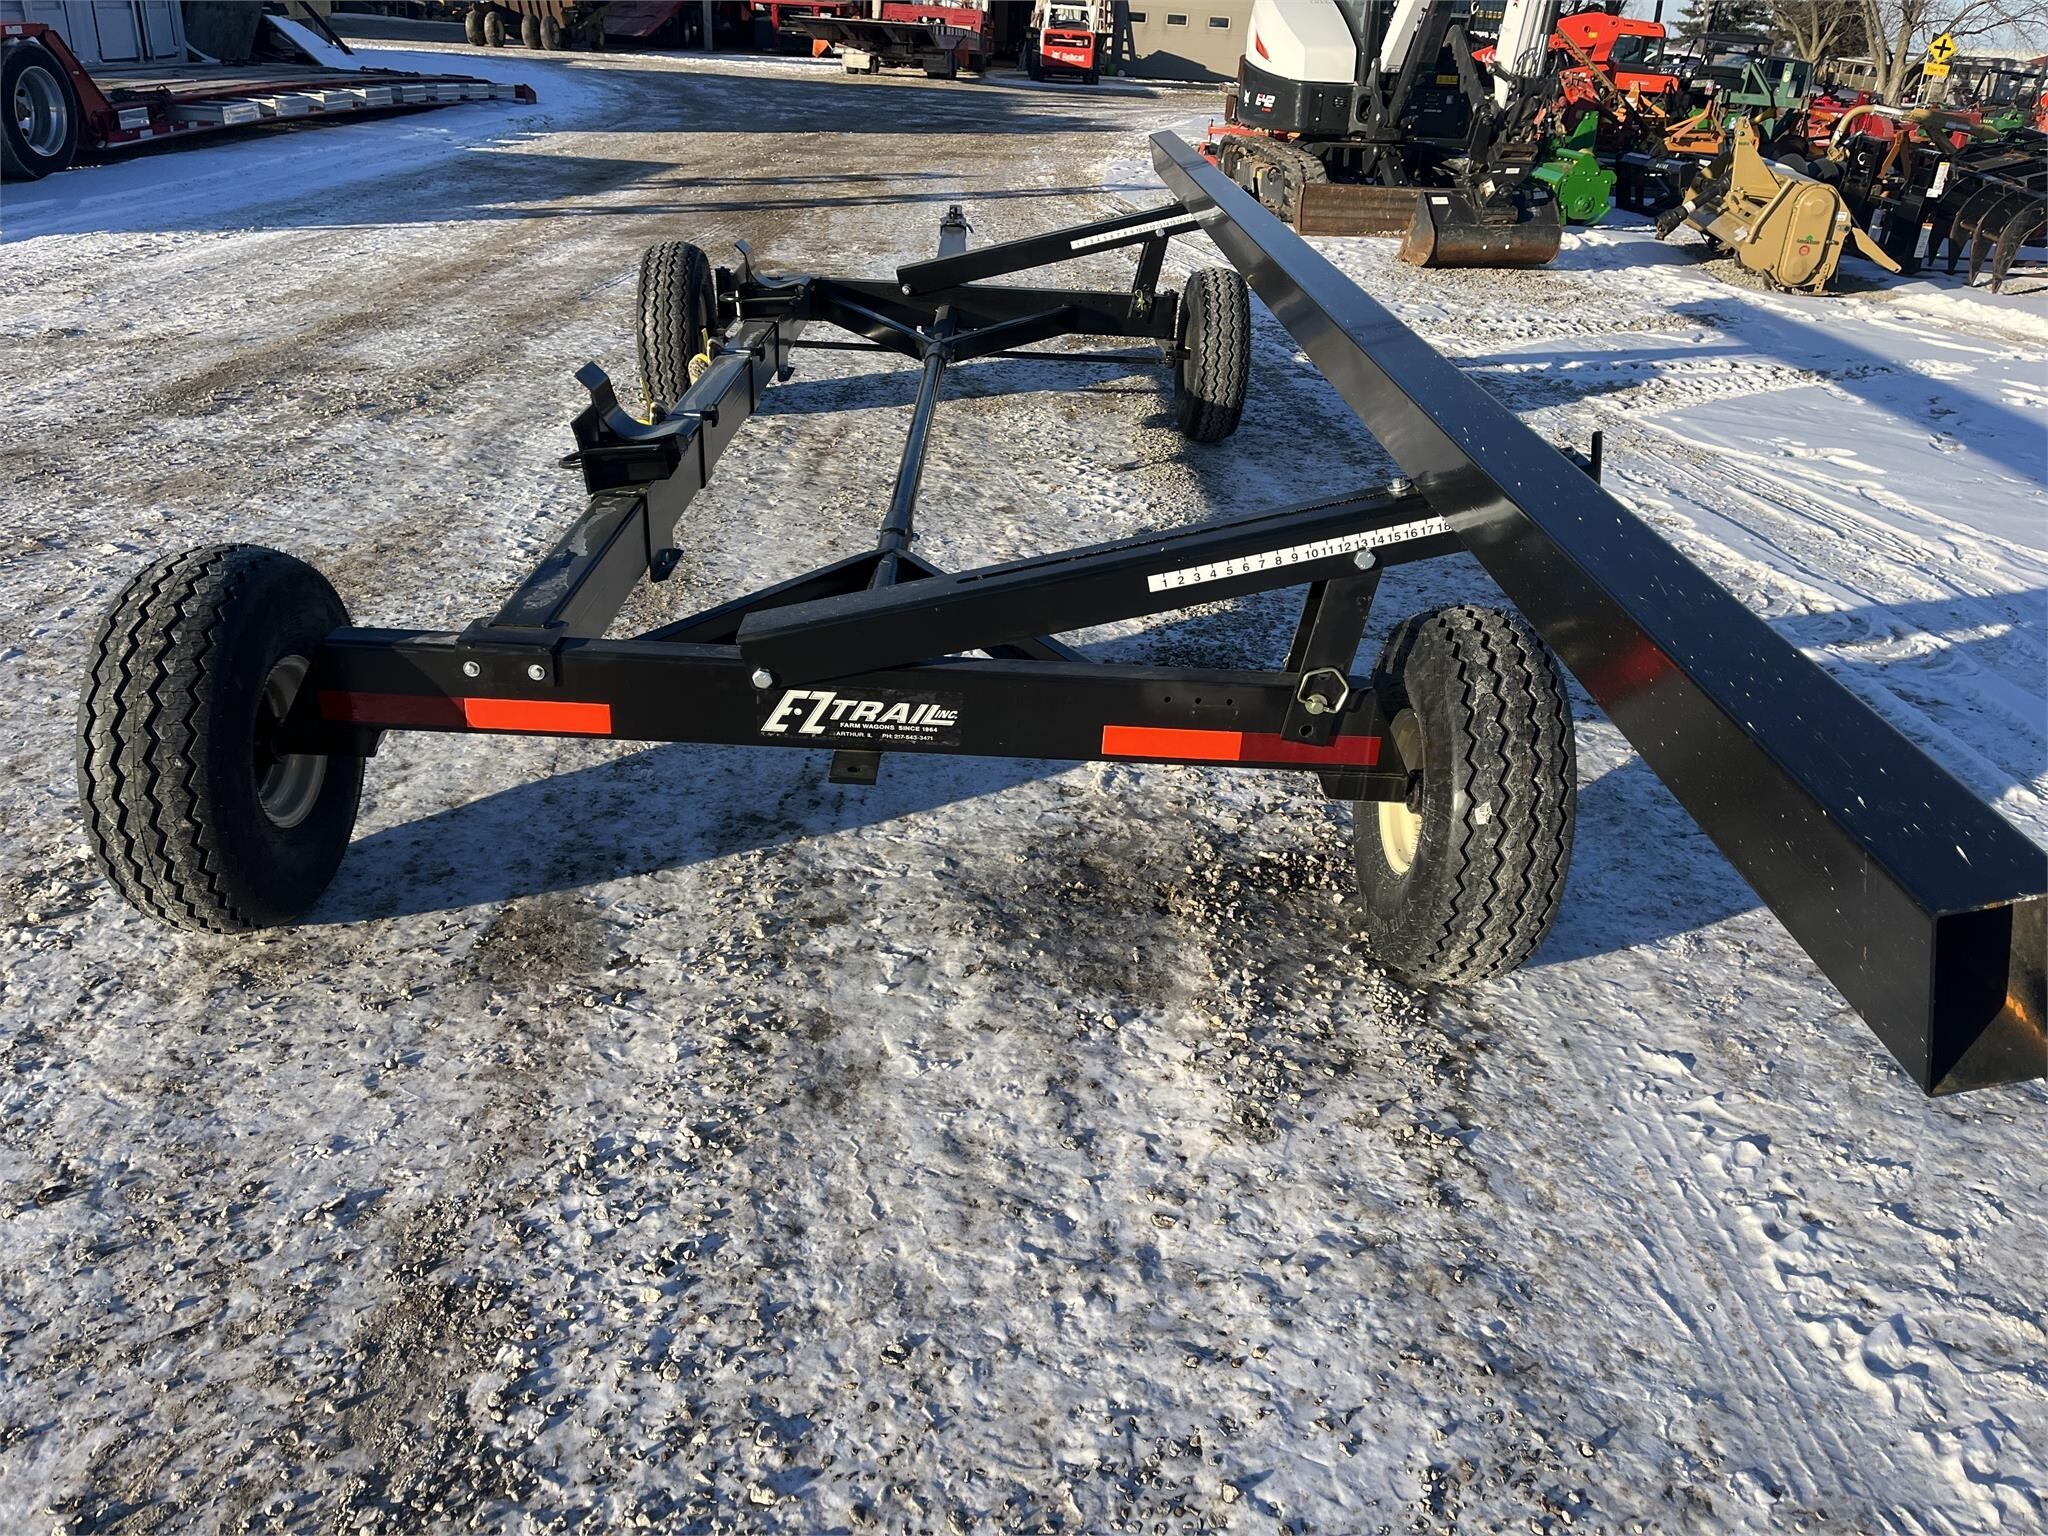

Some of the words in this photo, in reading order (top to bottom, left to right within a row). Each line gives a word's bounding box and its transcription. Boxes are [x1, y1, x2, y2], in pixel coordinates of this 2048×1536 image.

[1162, 579, 1168, 588] 1
[1177, 576, 1185, 585] 2
[1193, 573, 1201, 582] 3
[1210, 569, 1217, 578] 4
[1226, 566, 1234, 575] 5
[1242, 563, 1250, 572] 6
[1258, 559, 1266, 569] 7
[1275, 556, 1283, 565] 8
[1291, 553, 1299, 562] 9
[1305, 548, 1319, 559] 10
[1322, 545, 1334, 556] 11
[1338, 541, 1352, 553] 12
[1355, 538, 1369, 550] 13
[1371, 535, 1385, 546] 14
[1388, 532, 1402, 543] 15
[1404, 528, 1419, 540] 16
[1421, 524, 1434, 536] 17
[1438, 521, 1451, 532] 18
[830, 699, 956, 726] TRAIL
[934, 709, 959, 720] INC.
[862, 723, 895, 731] WAGONS
